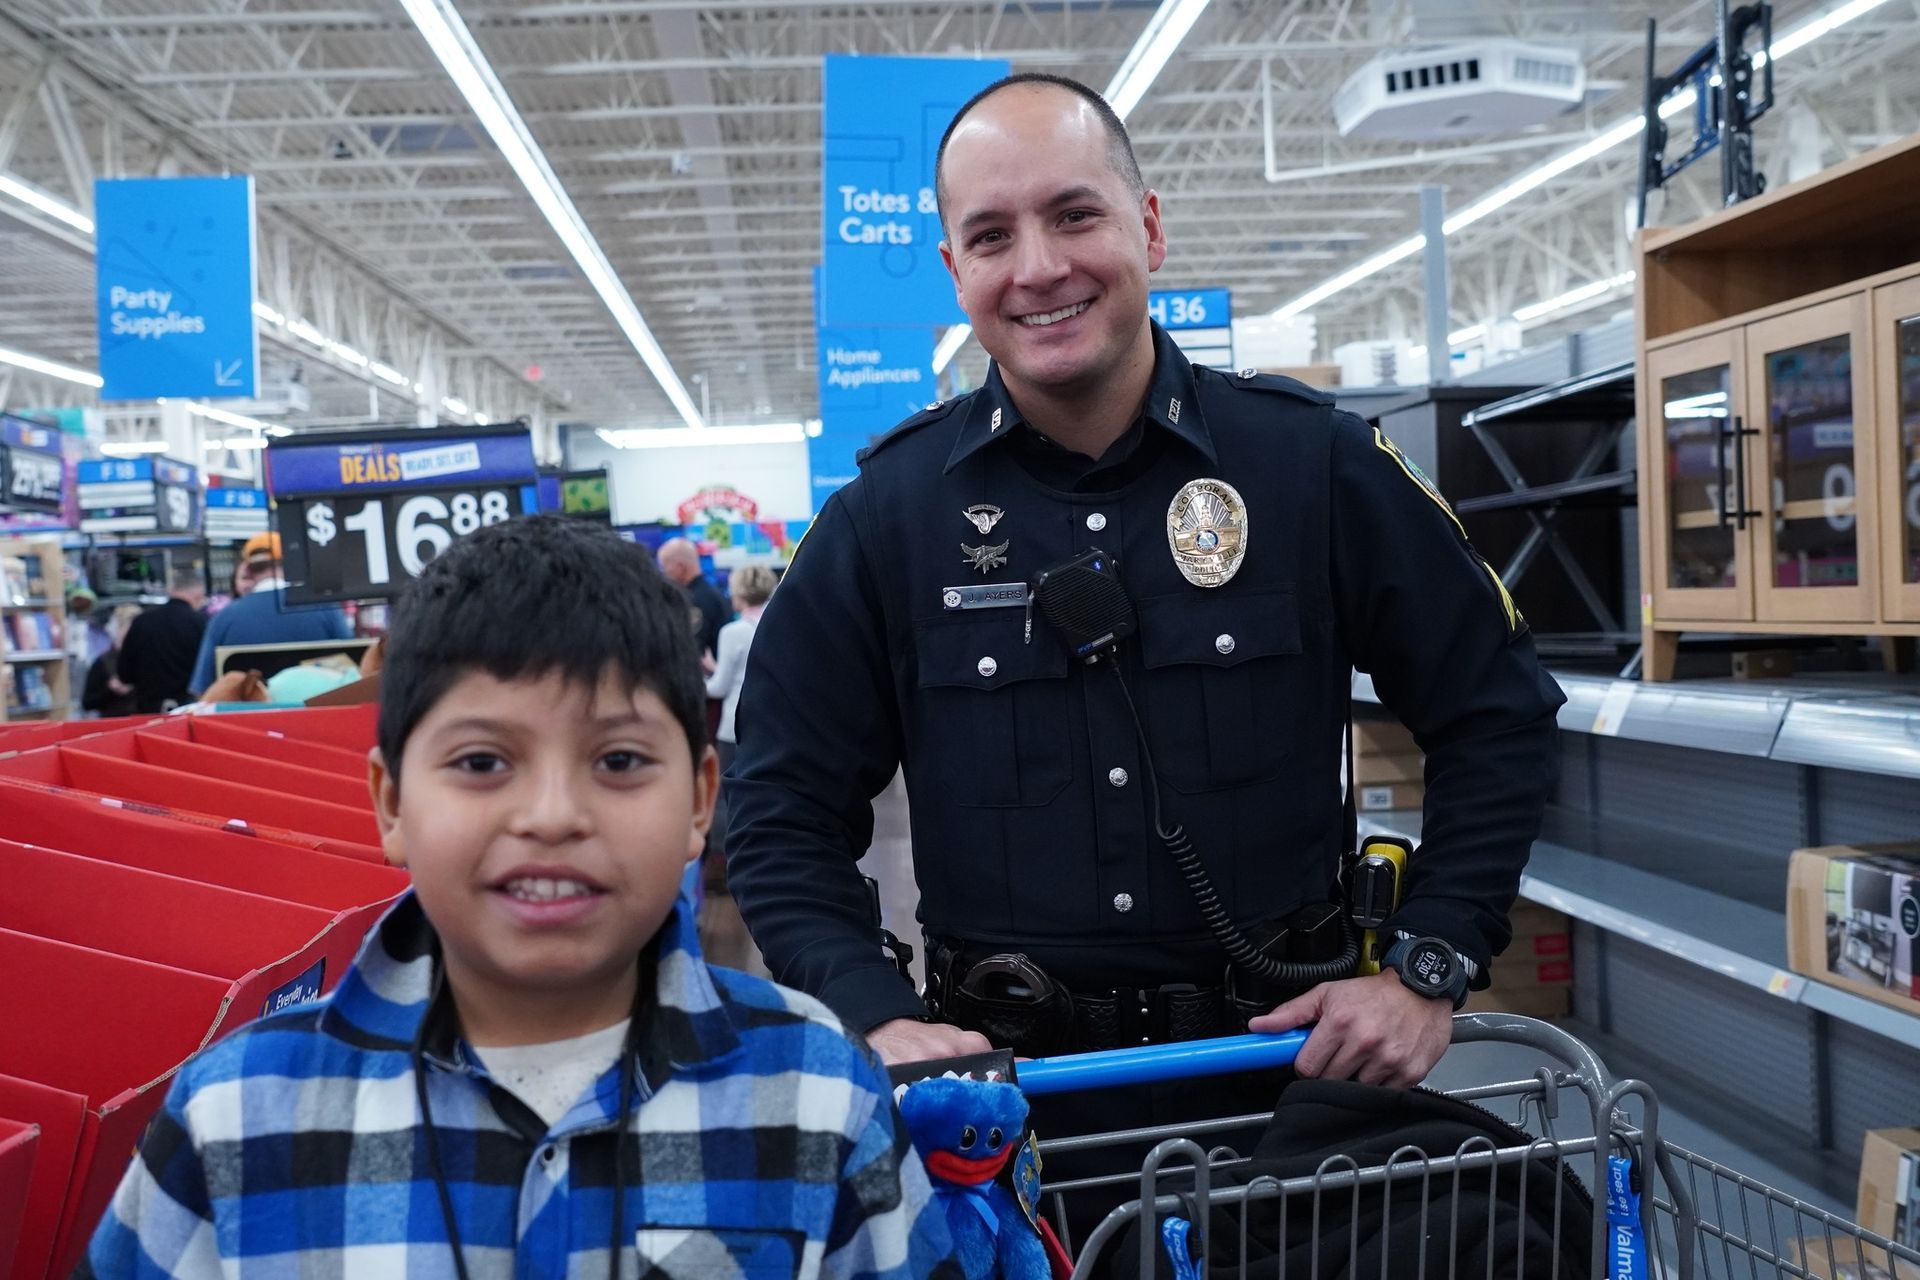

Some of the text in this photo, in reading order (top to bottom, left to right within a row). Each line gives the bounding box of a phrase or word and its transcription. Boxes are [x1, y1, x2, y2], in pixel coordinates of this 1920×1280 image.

[839, 186, 940, 214] Totes &
[839, 217, 913, 244] Carts
[110, 286, 172, 313] Party
[111, 312, 205, 339] Supplies
[827, 348, 881, 365] Home
[828, 367, 921, 388] Appliances
[340, 453, 401, 484] DEALS
[1177, 484, 1234, 512] CORPORAL
[985, 590, 1023, 601] AYERS
[1418, 951, 1437, 975] 0730
[1612, 1166, 1624, 1194] seat
